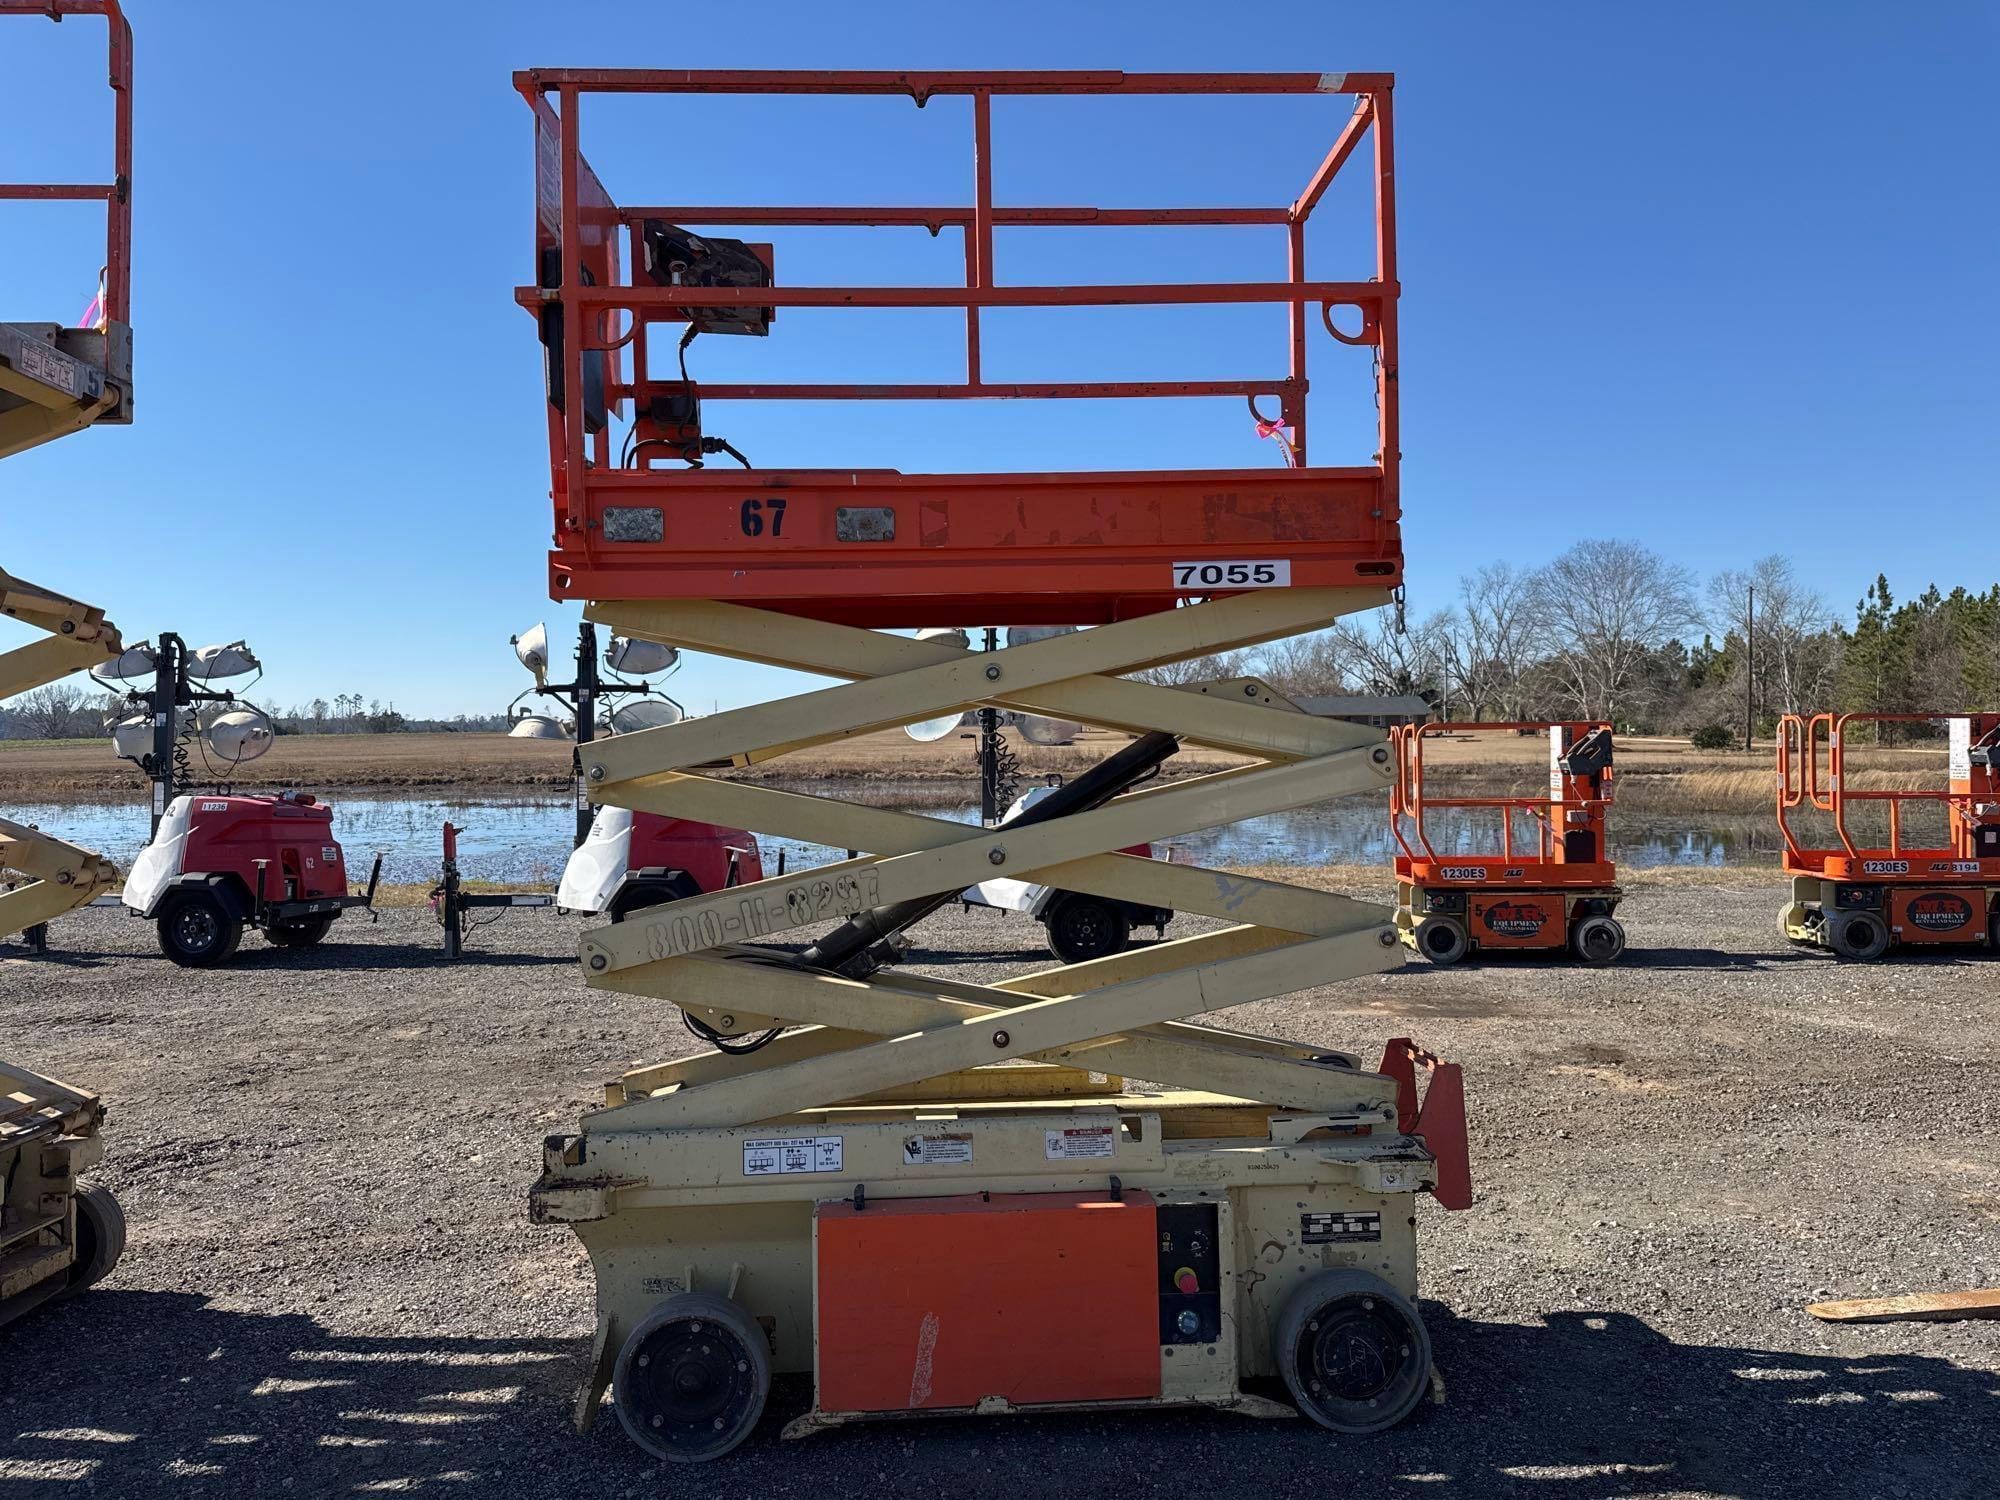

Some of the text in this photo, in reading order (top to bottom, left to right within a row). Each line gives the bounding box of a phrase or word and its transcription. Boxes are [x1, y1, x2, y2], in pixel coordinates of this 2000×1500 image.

[741, 499, 787, 537] 67
[1173, 564, 1276, 585] 7055
[305, 857, 315, 869] 62
[1844, 860, 1853, 873] 3
[1864, 862, 1908, 873] 1230ES
[1930, 863, 1949, 871] JLG
[1951, 863, 1978, 872] 8194
[1442, 868, 1486, 879] 1230ES
[1503, 869, 1524, 877] JLG
